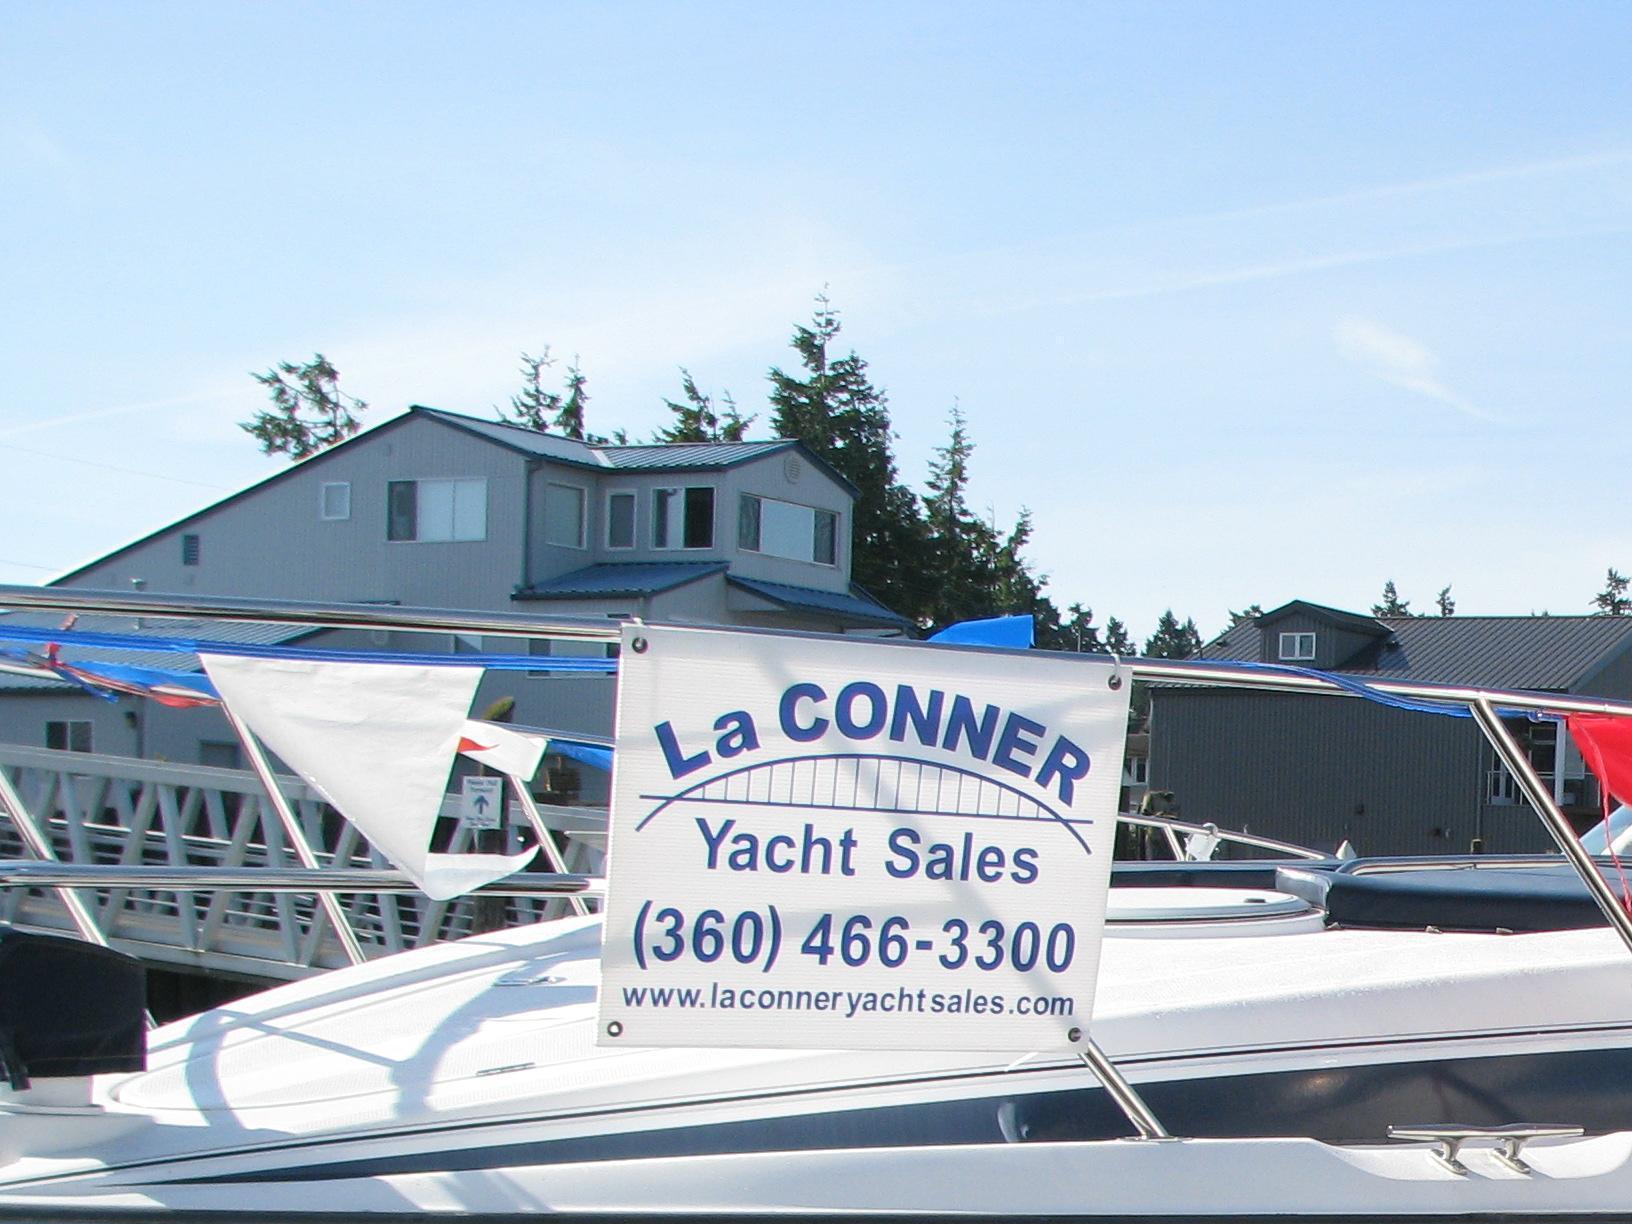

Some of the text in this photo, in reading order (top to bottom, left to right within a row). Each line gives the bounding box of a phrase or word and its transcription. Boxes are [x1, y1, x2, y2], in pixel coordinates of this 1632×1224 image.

[654, 681, 1091, 806] La CONNER
[696, 818, 1039, 884] Yacht Sales
[633, 901, 1075, 973] (360) 466-3300
[622, 982, 1075, 1018] www.laconneryachtsales.com
